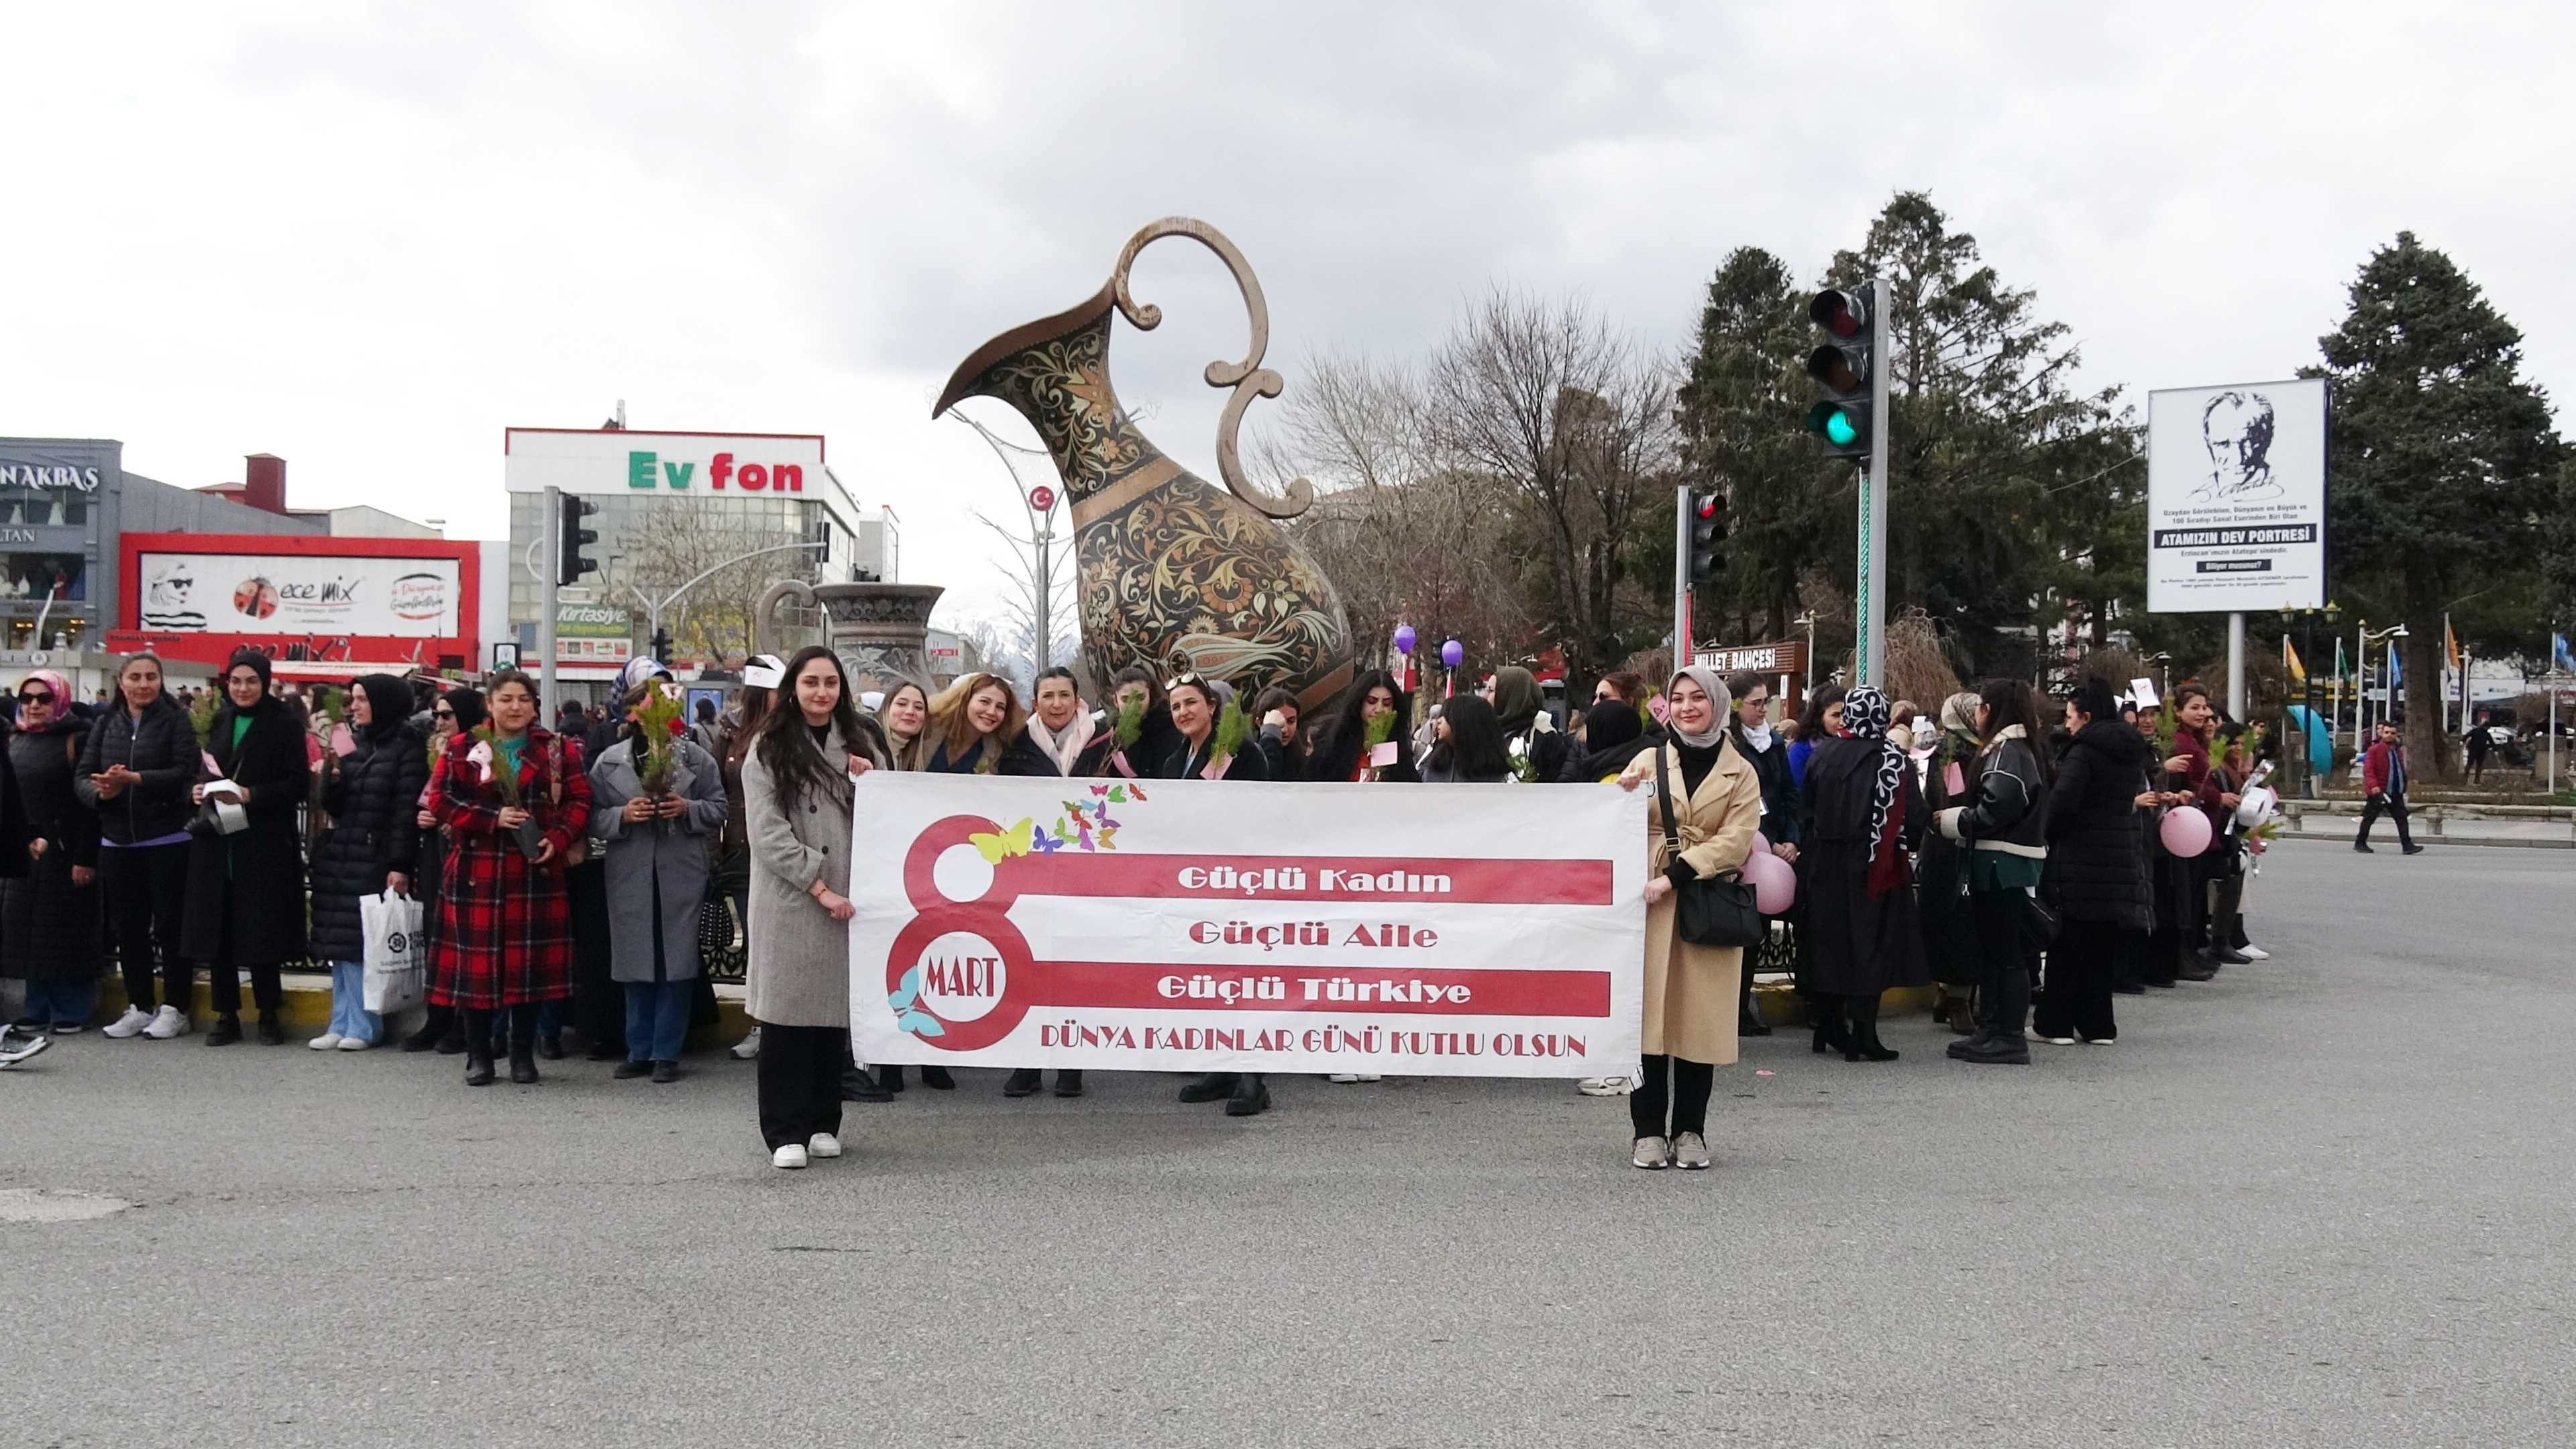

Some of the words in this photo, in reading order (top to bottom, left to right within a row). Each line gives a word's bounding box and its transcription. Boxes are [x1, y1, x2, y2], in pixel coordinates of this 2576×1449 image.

[629, 451, 695, 489] Ev
[710, 452, 802, 491] fon
[0, 529, 35, 542] TAN
[2161, 532, 2218, 546] ATAMIZIN
[2220, 531, 2245, 544] DEV
[2249, 526, 2310, 543] PORTRESİ
[1695, 652, 1727, 671] MİLLET
[1731, 648, 1776, 671] BAHÇESİ
[1178, 865, 1307, 895] Güçlü
[1320, 869, 1451, 893] Kadın
[1189, 920, 1330, 951] Güçlü
[1343, 923, 1439, 947] Aile
[924, 955, 999, 997] MART
[1157, 974, 1286, 1004] Güçlü
[1297, 977, 1472, 1004] Türkiye
[1040, 1019, 1136, 1049] DÜNYA
[1144, 1027, 1295, 1052] KADINLAR
[1302, 1024, 1382, 1054] GÜNÜ
[1391, 1032, 1485, 1055] KUTLU
[1493, 1033, 1586, 1058] OLSUN
